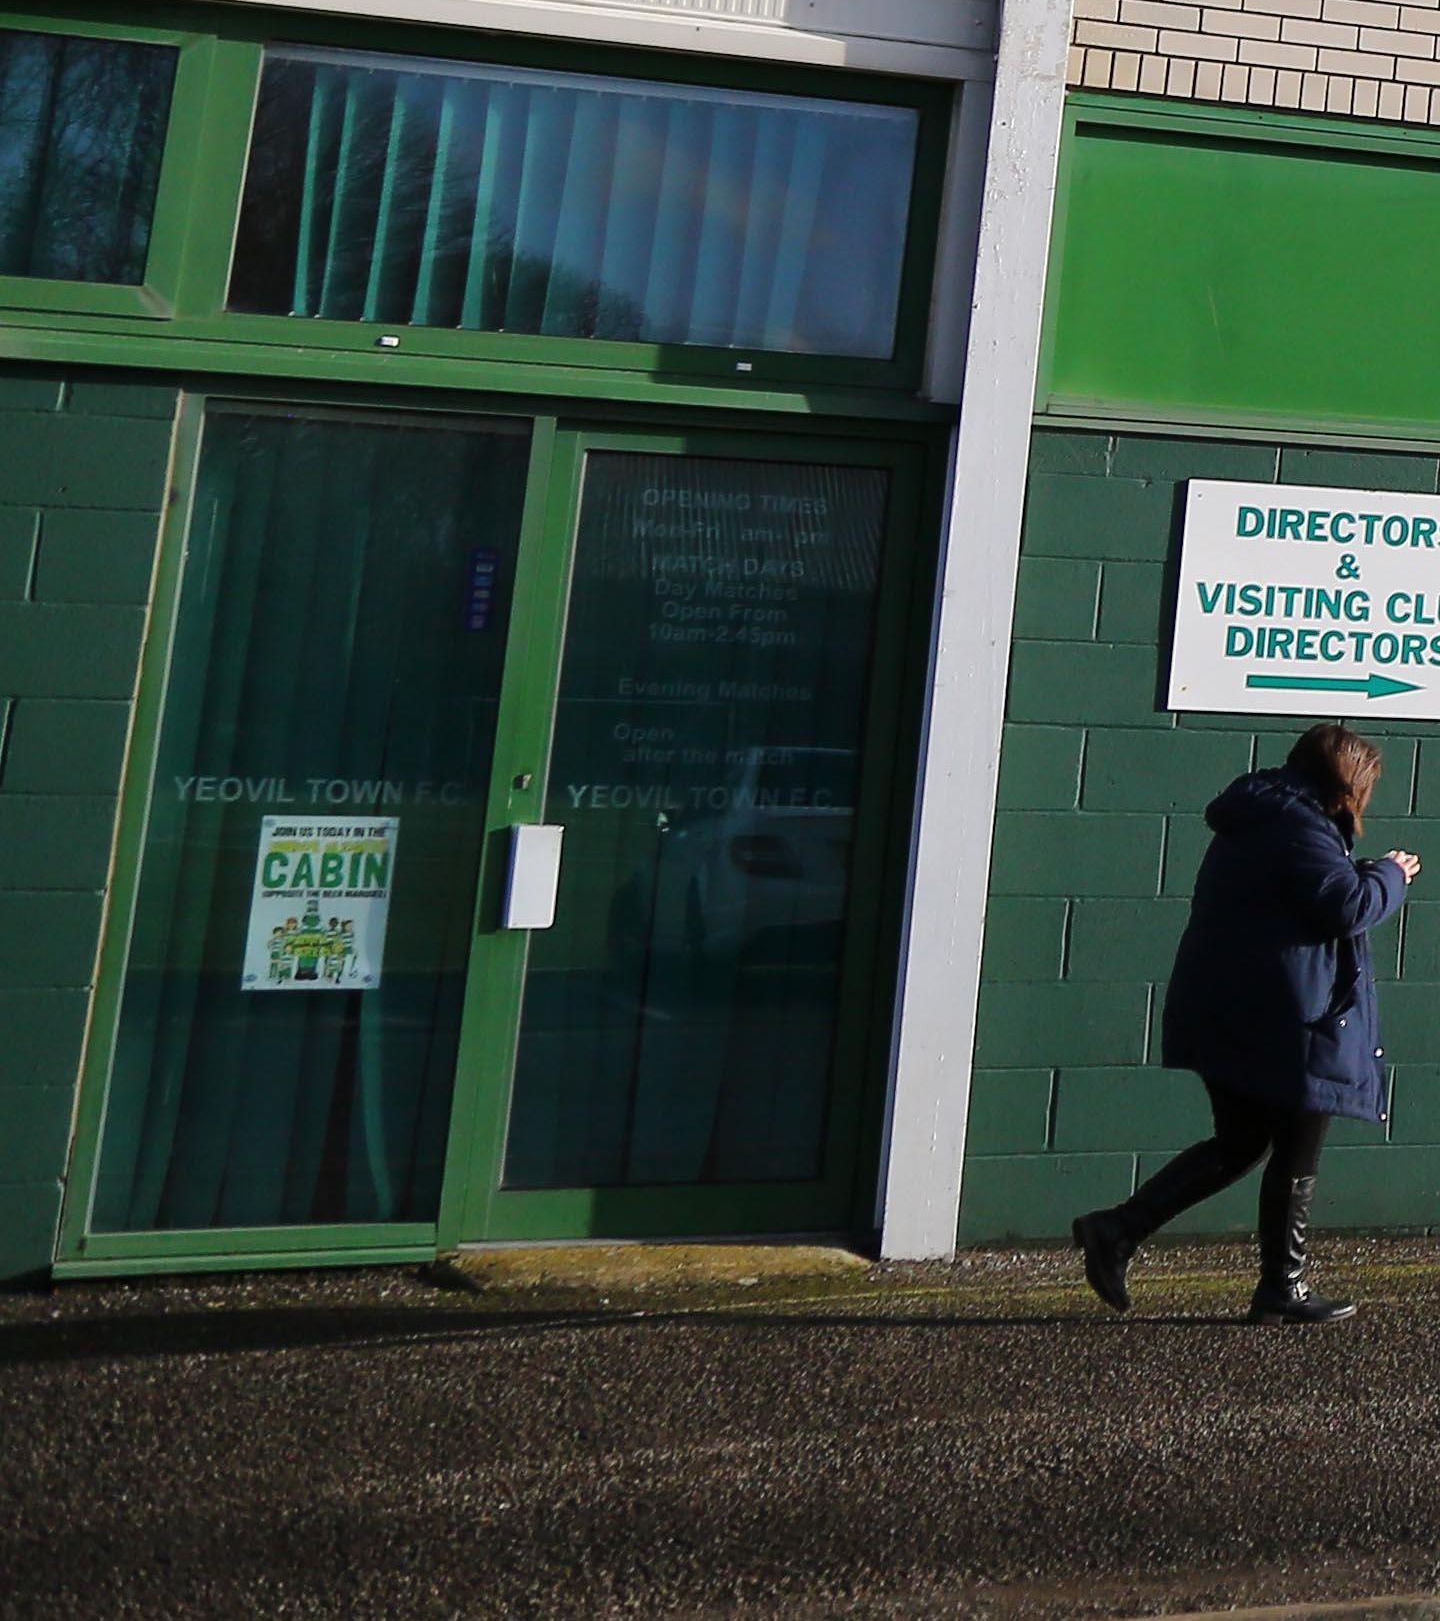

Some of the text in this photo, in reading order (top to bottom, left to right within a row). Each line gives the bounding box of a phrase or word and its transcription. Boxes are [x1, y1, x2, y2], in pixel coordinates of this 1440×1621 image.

[652, 554, 805, 579] MATCH DAYS
[1336, 553, 1361, 580] &
[655, 578, 799, 601] Day Matches
[1196, 581, 1370, 622] VISITING
[661, 600, 787, 622] Open From
[618, 678, 812, 701] Evening Matches
[613, 723, 674, 744] Open
[623, 745, 675, 764] after
[682, 747, 718, 764] the
[174, 775, 467, 806] YEOVIL TOWN F.C.
[567, 782, 681, 810] YEOVIL
[687, 785, 779, 811] TOWN
[366, 826, 388, 838] THE
[262, 851, 389, 889] CABIN
